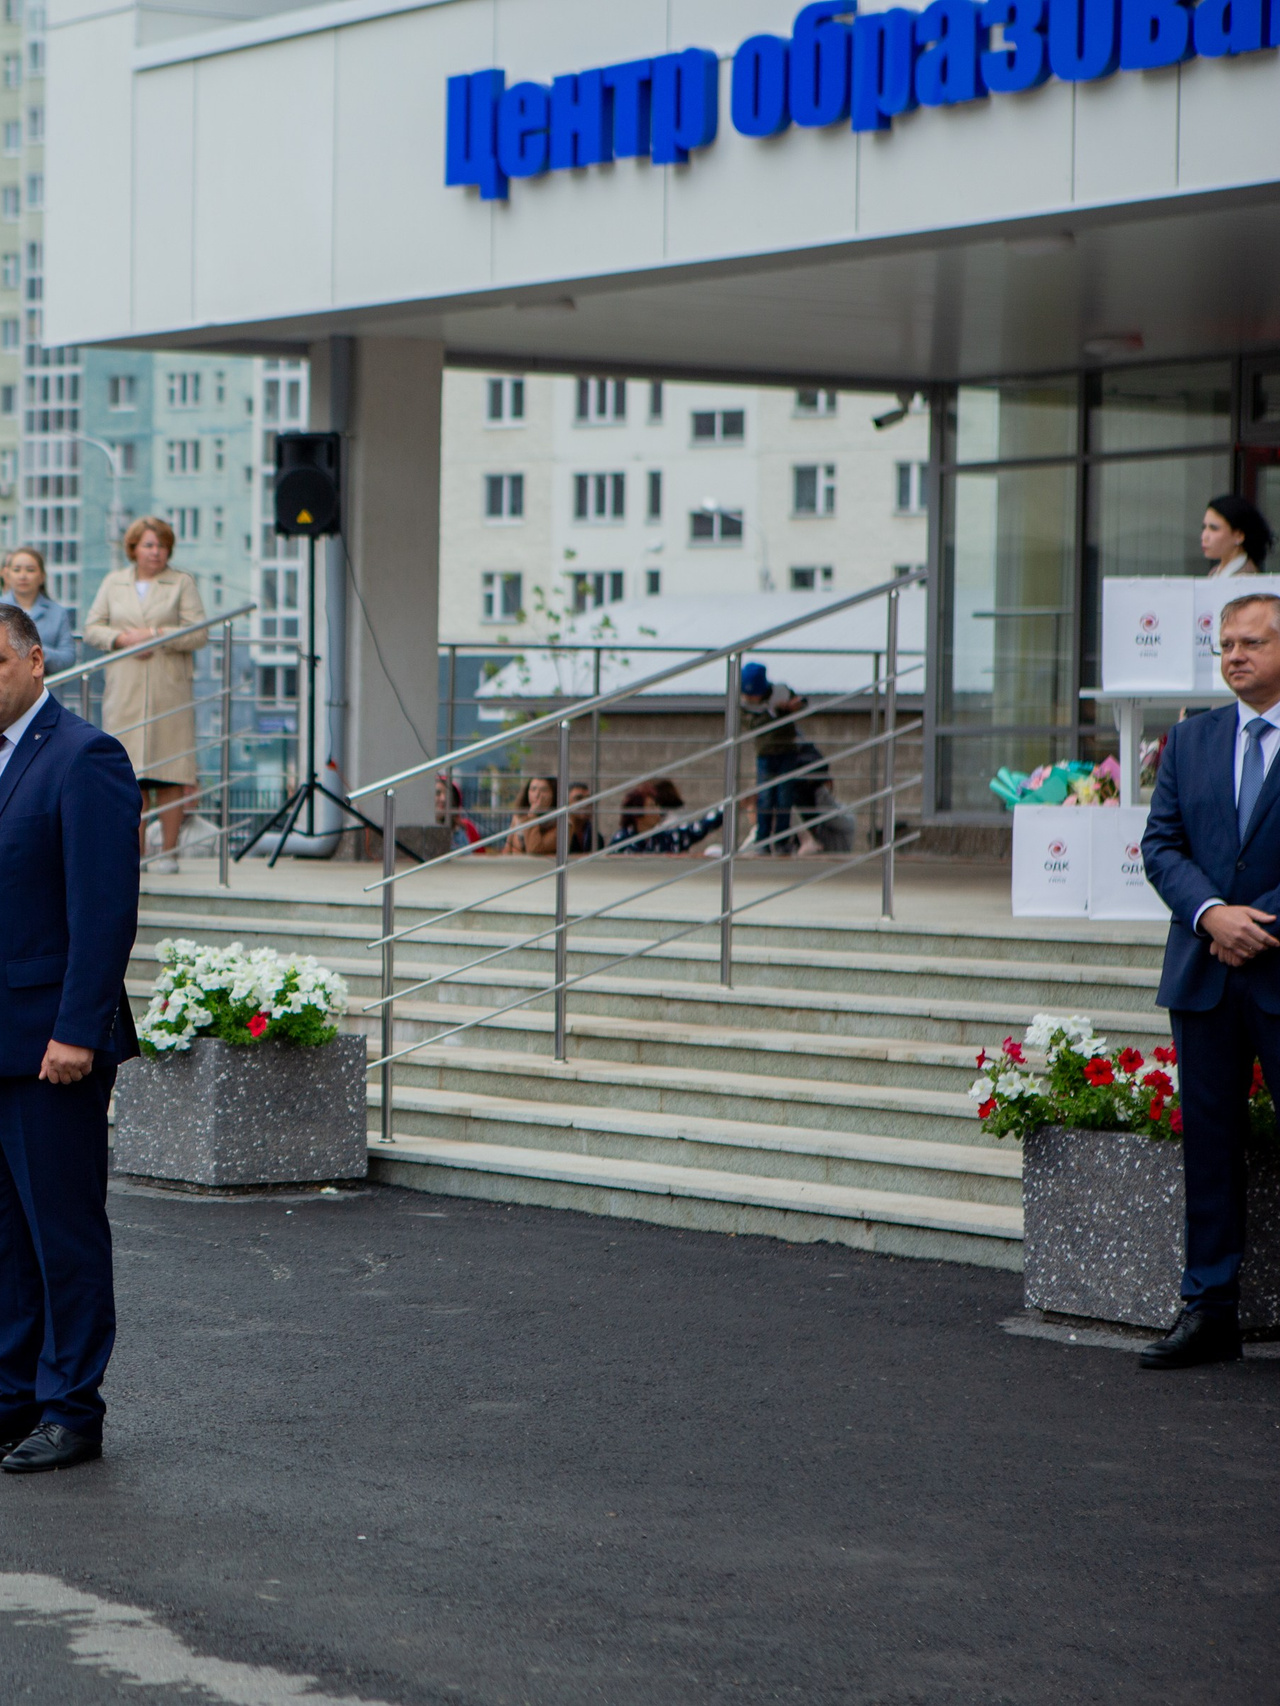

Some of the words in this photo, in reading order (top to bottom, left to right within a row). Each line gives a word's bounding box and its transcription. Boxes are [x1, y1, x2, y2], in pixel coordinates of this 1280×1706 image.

[445, 46, 718, 201] Центр
[731, 0, 1280, 137] образова
[1135, 634, 1162, 647] ОДК
[1043, 860, 1070, 873] ОДК
